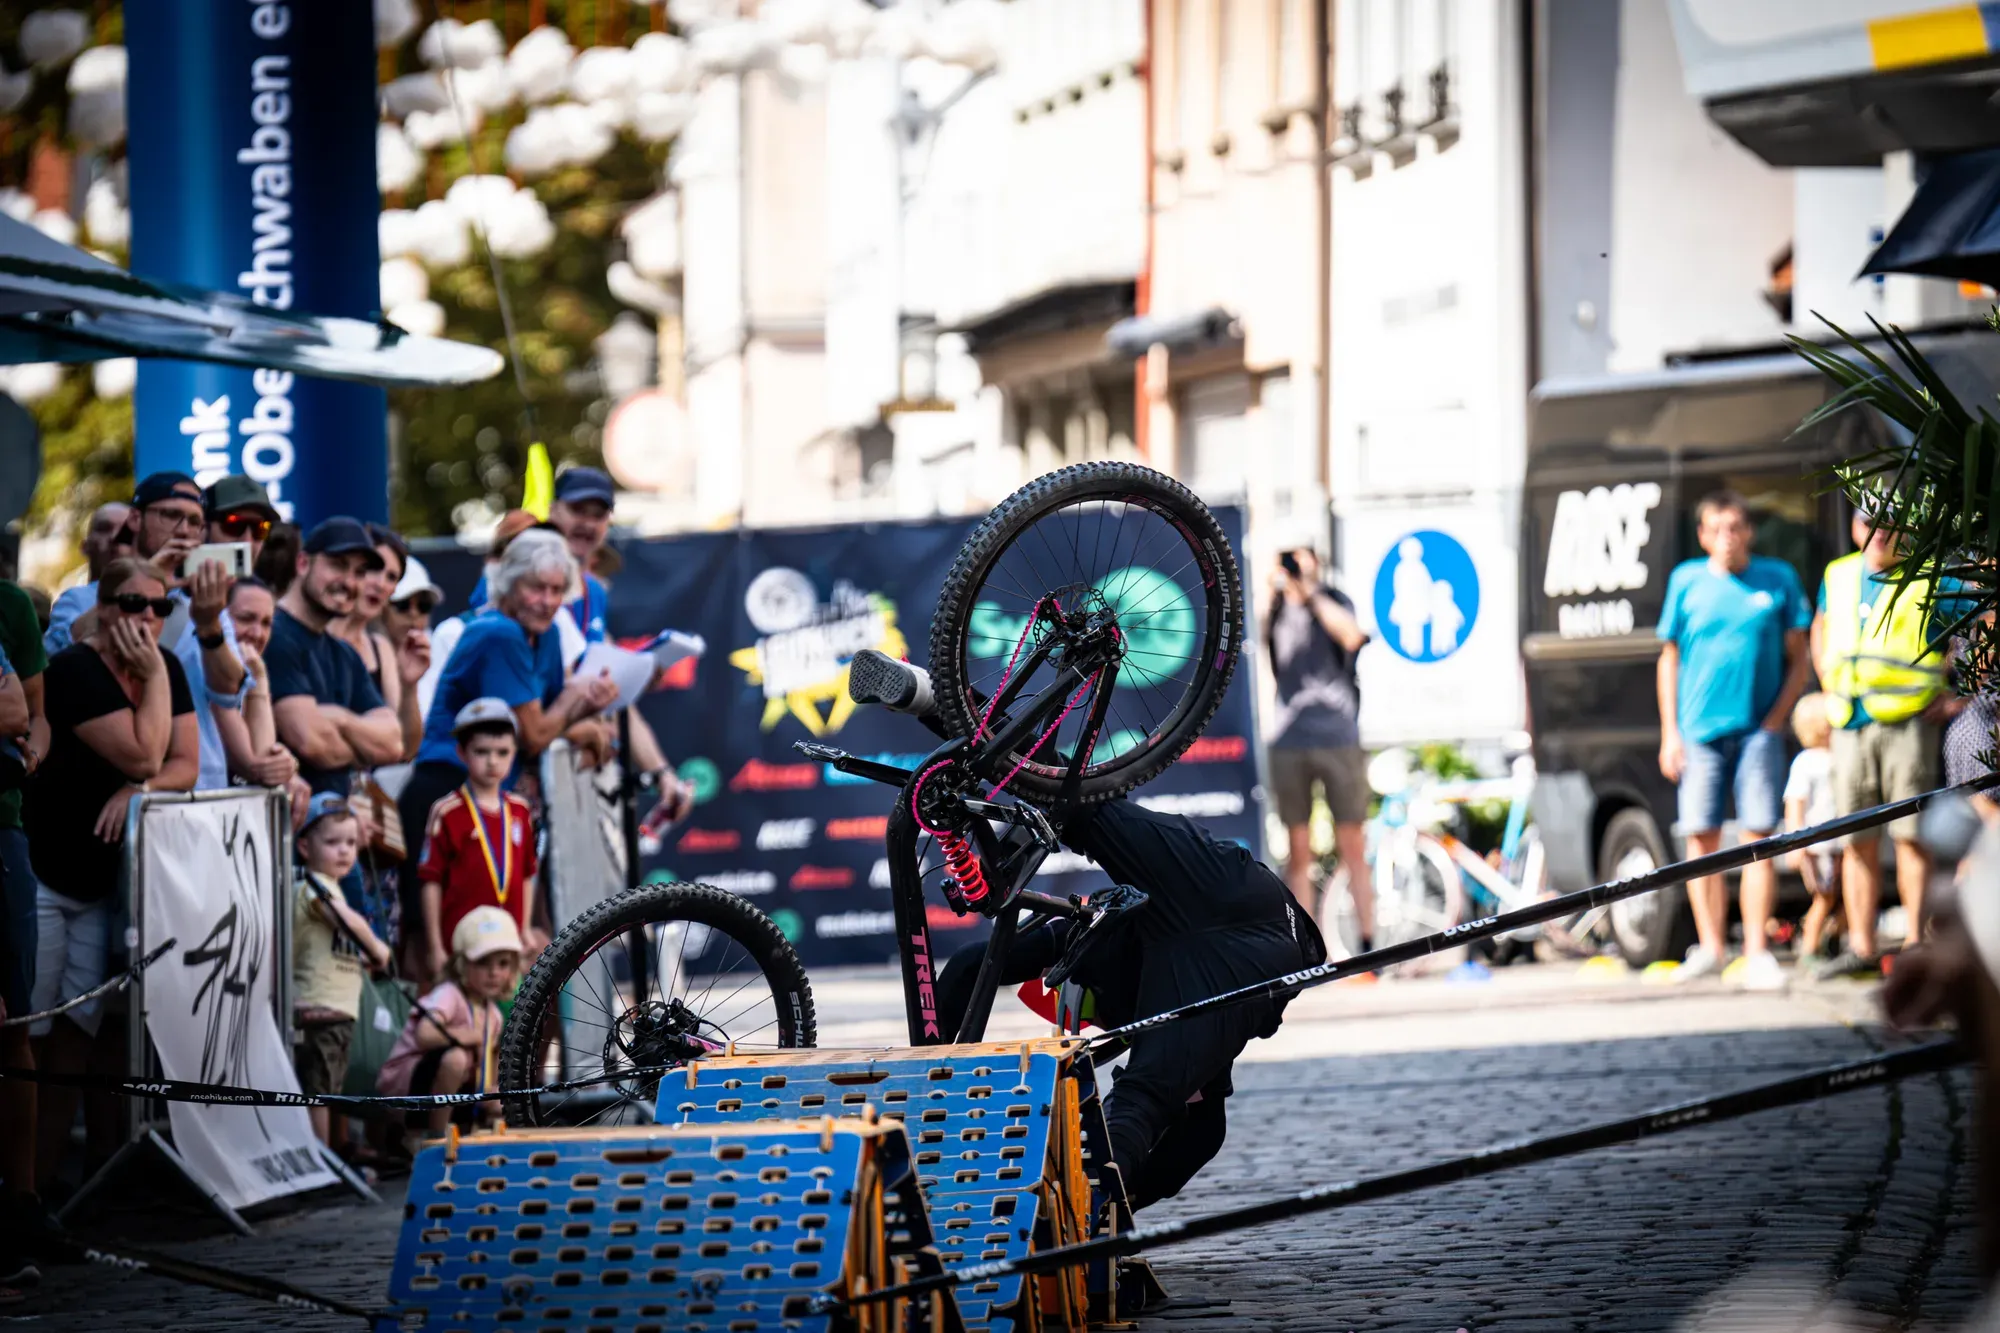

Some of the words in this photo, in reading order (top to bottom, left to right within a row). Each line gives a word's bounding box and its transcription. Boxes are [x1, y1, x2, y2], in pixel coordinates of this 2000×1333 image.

[250, 0, 291, 39] e
[1202, 537, 1231, 651] SCHWALBE
[789, 991, 804, 1048] SCHW
[911, 926, 940, 1039] TREK
